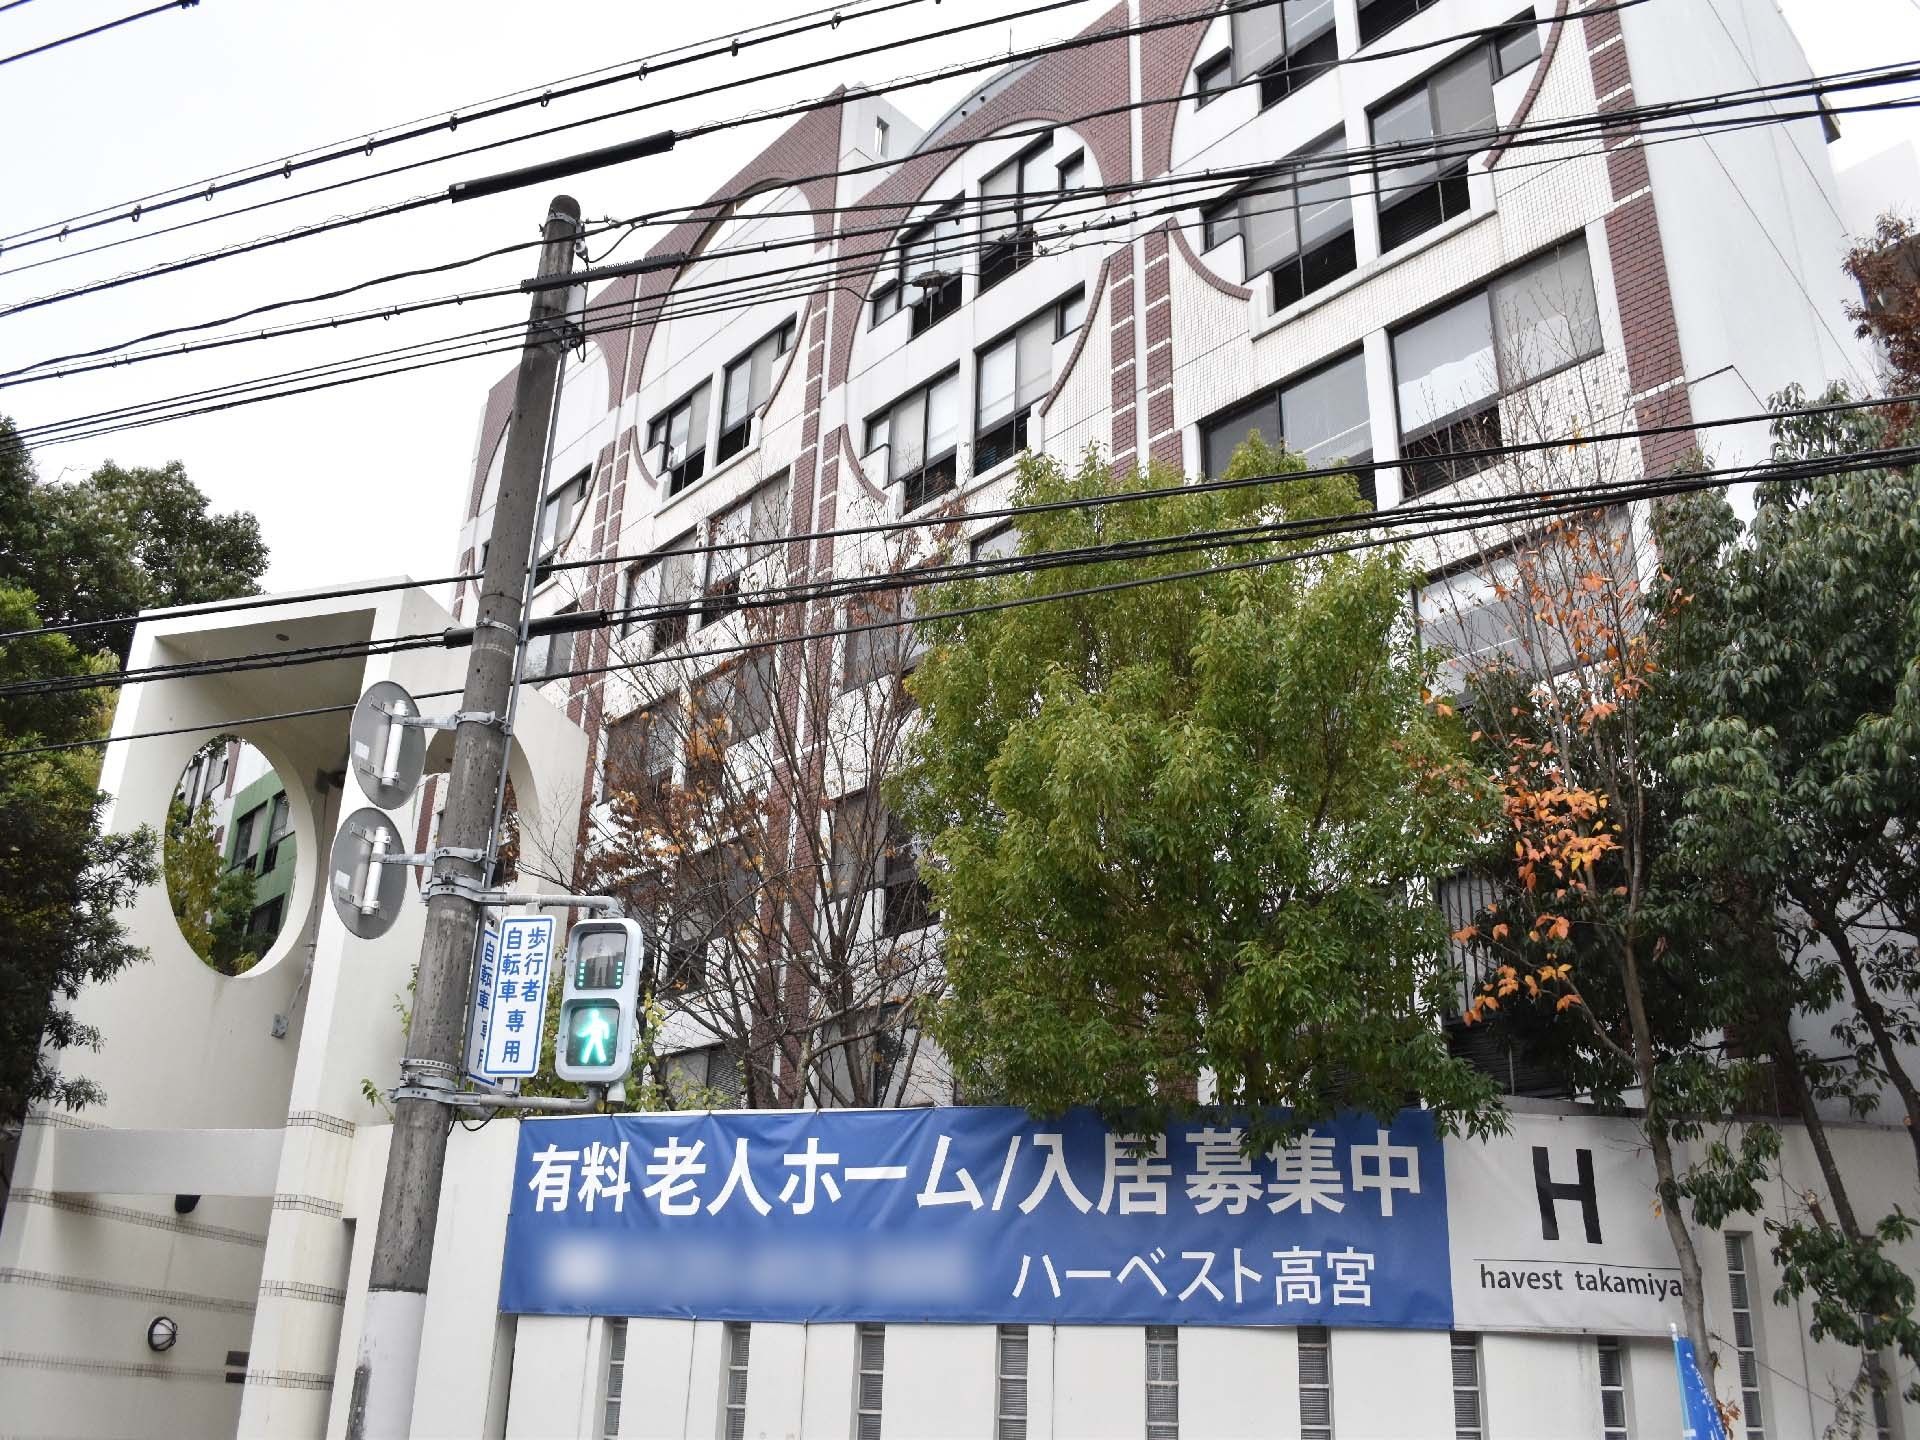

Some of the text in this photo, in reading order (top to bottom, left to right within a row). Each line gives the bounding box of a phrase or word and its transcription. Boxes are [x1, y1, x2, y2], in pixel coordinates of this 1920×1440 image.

[498, 927, 522, 1003] 自転車
[522, 926, 547, 1002] 歩行者
[502, 1009, 526, 1064] 専用
[1531, 1145, 1603, 1245] H
[1011, 1246, 1375, 1307] ハーベスト高宮
[1480, 1263, 1683, 1302] havest takamiya
